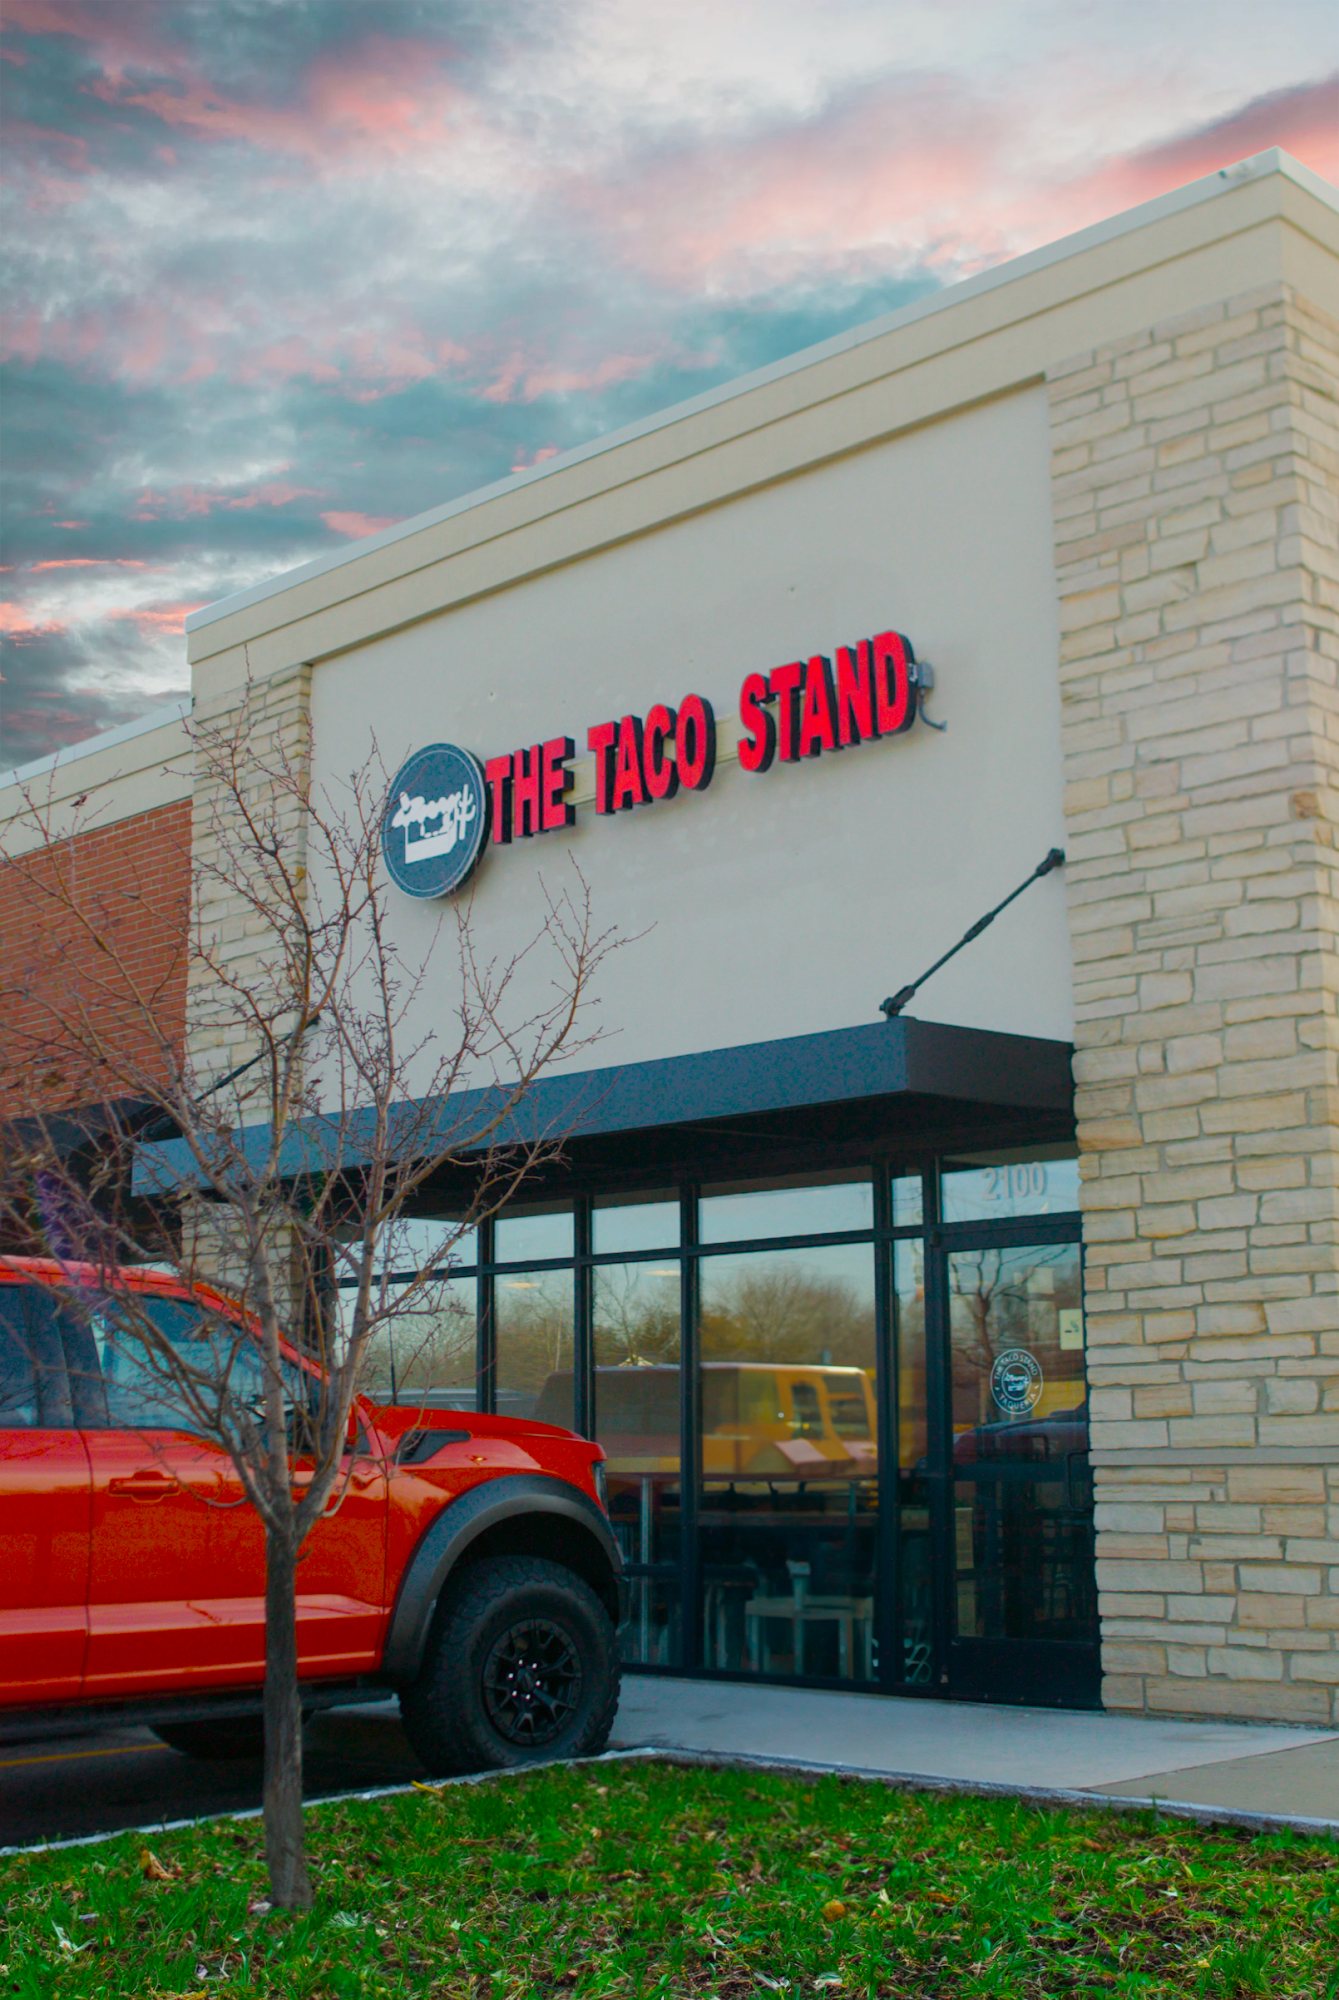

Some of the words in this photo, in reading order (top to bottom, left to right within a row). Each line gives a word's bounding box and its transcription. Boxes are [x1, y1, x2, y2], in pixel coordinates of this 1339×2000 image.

[485, 736, 575, 845] THE
[587, 693, 716, 815] TACO
[737, 630, 918, 773] STAND
[982, 1161, 1045, 1200] 2100
[1000, 1353, 1019, 1365] TACO
[1019, 1354, 1038, 1376] STAND
[999, 1393, 1037, 1410] TAQUERIA
